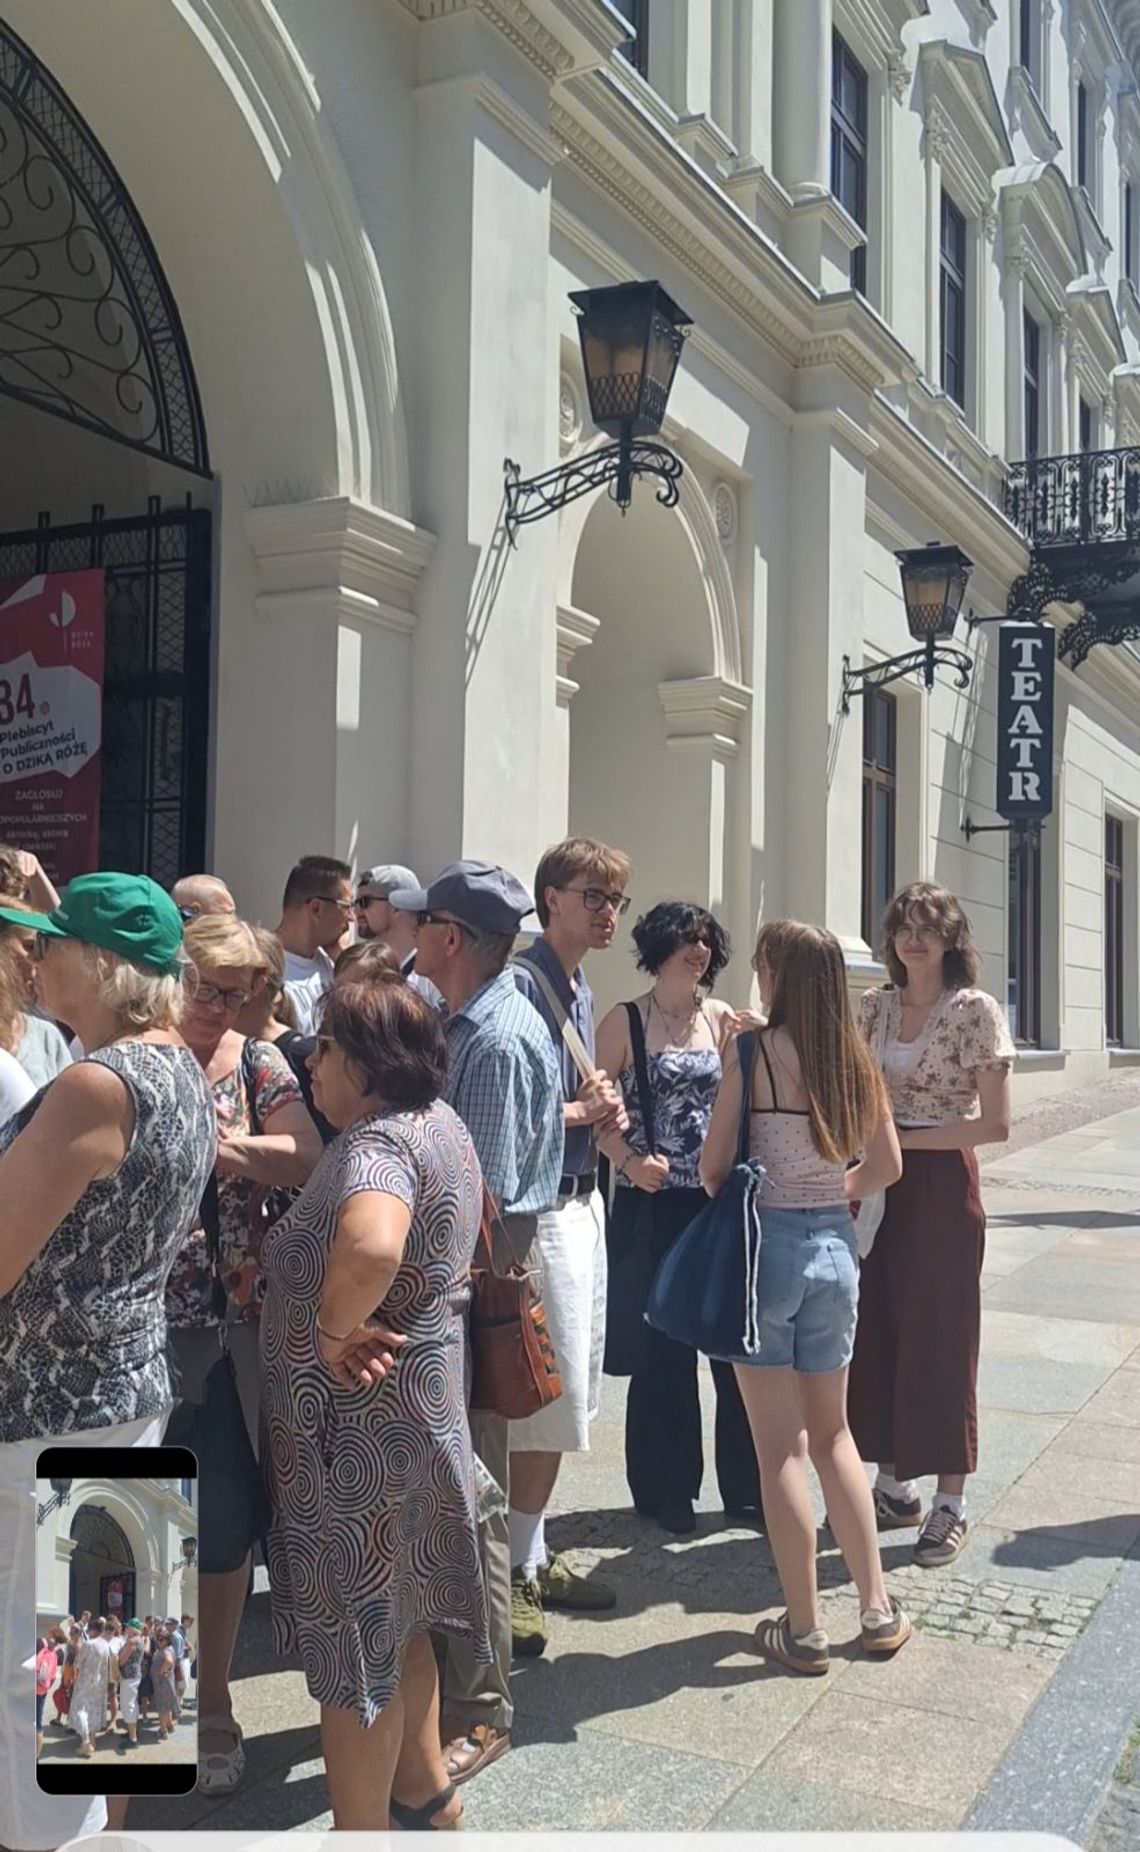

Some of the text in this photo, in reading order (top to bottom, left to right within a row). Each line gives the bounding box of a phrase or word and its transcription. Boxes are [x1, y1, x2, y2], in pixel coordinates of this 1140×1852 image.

[0, 721, 54, 743] Plebiscyt
[1008, 638, 1043, 801] TEATR
[1, 726, 76, 759] Publiczności
[3, 763, 13, 774] O
